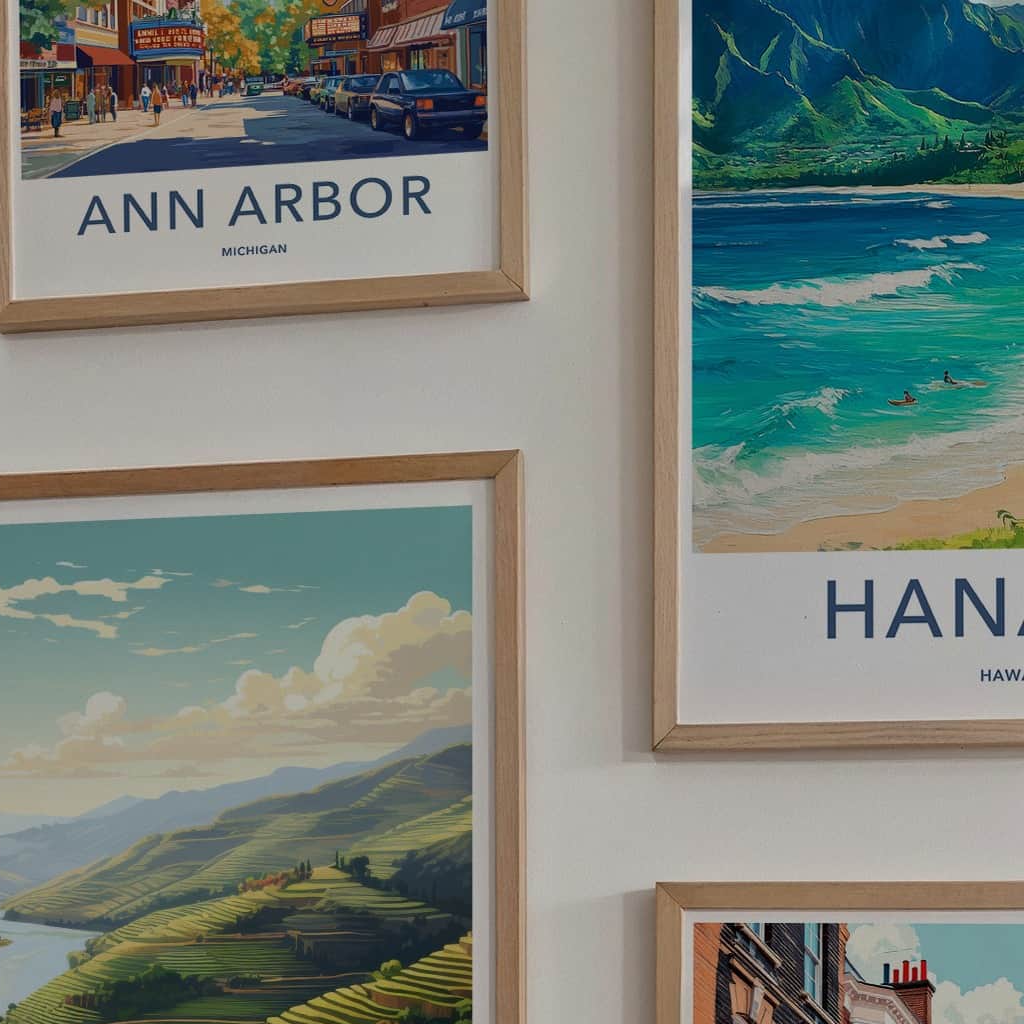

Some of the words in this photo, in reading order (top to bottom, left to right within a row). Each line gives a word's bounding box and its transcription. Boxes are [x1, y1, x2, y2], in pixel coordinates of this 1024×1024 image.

[77, 188, 205, 236] ANN
[228, 175, 432, 227] ARBOR
[221, 243, 288, 257] MICHIGAN
[826, 577, 1024, 639] HAN
[980, 668, 1024, 682] HAW
